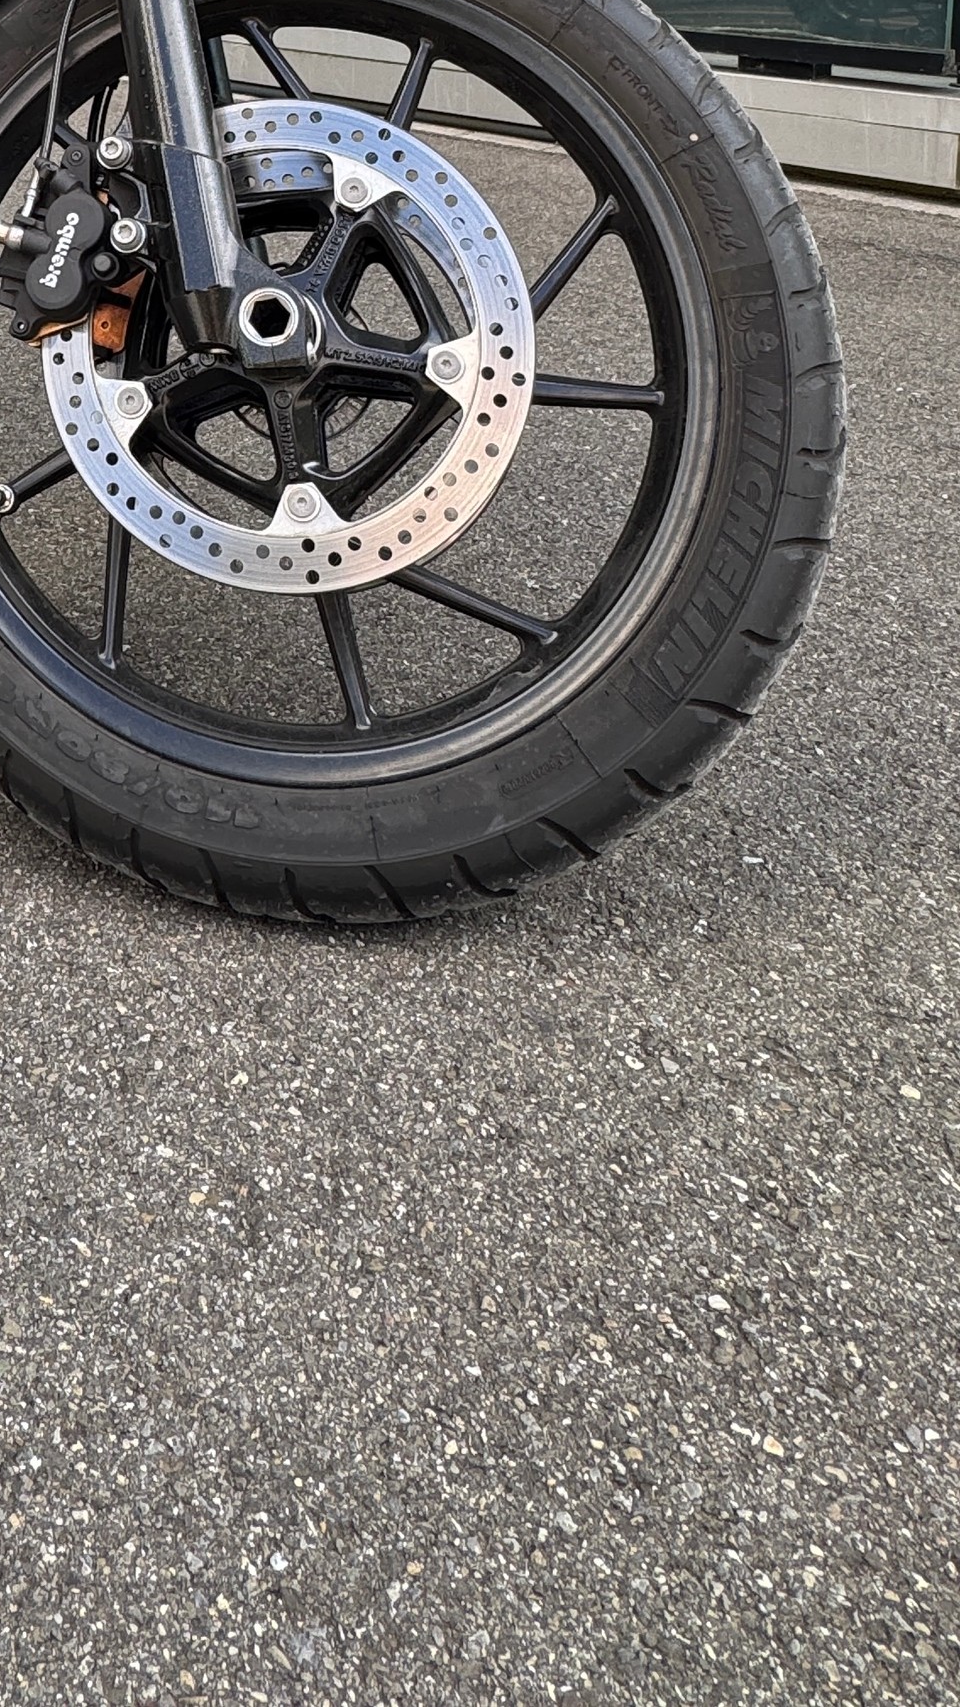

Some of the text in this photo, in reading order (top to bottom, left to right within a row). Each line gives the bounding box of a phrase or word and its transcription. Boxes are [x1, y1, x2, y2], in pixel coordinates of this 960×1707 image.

[621, 65, 665, 115] FRONT
[680, 153, 749, 253] Radial
[38, 212, 80, 288] brembo
[651, 373, 785, 699] MICHELIN
